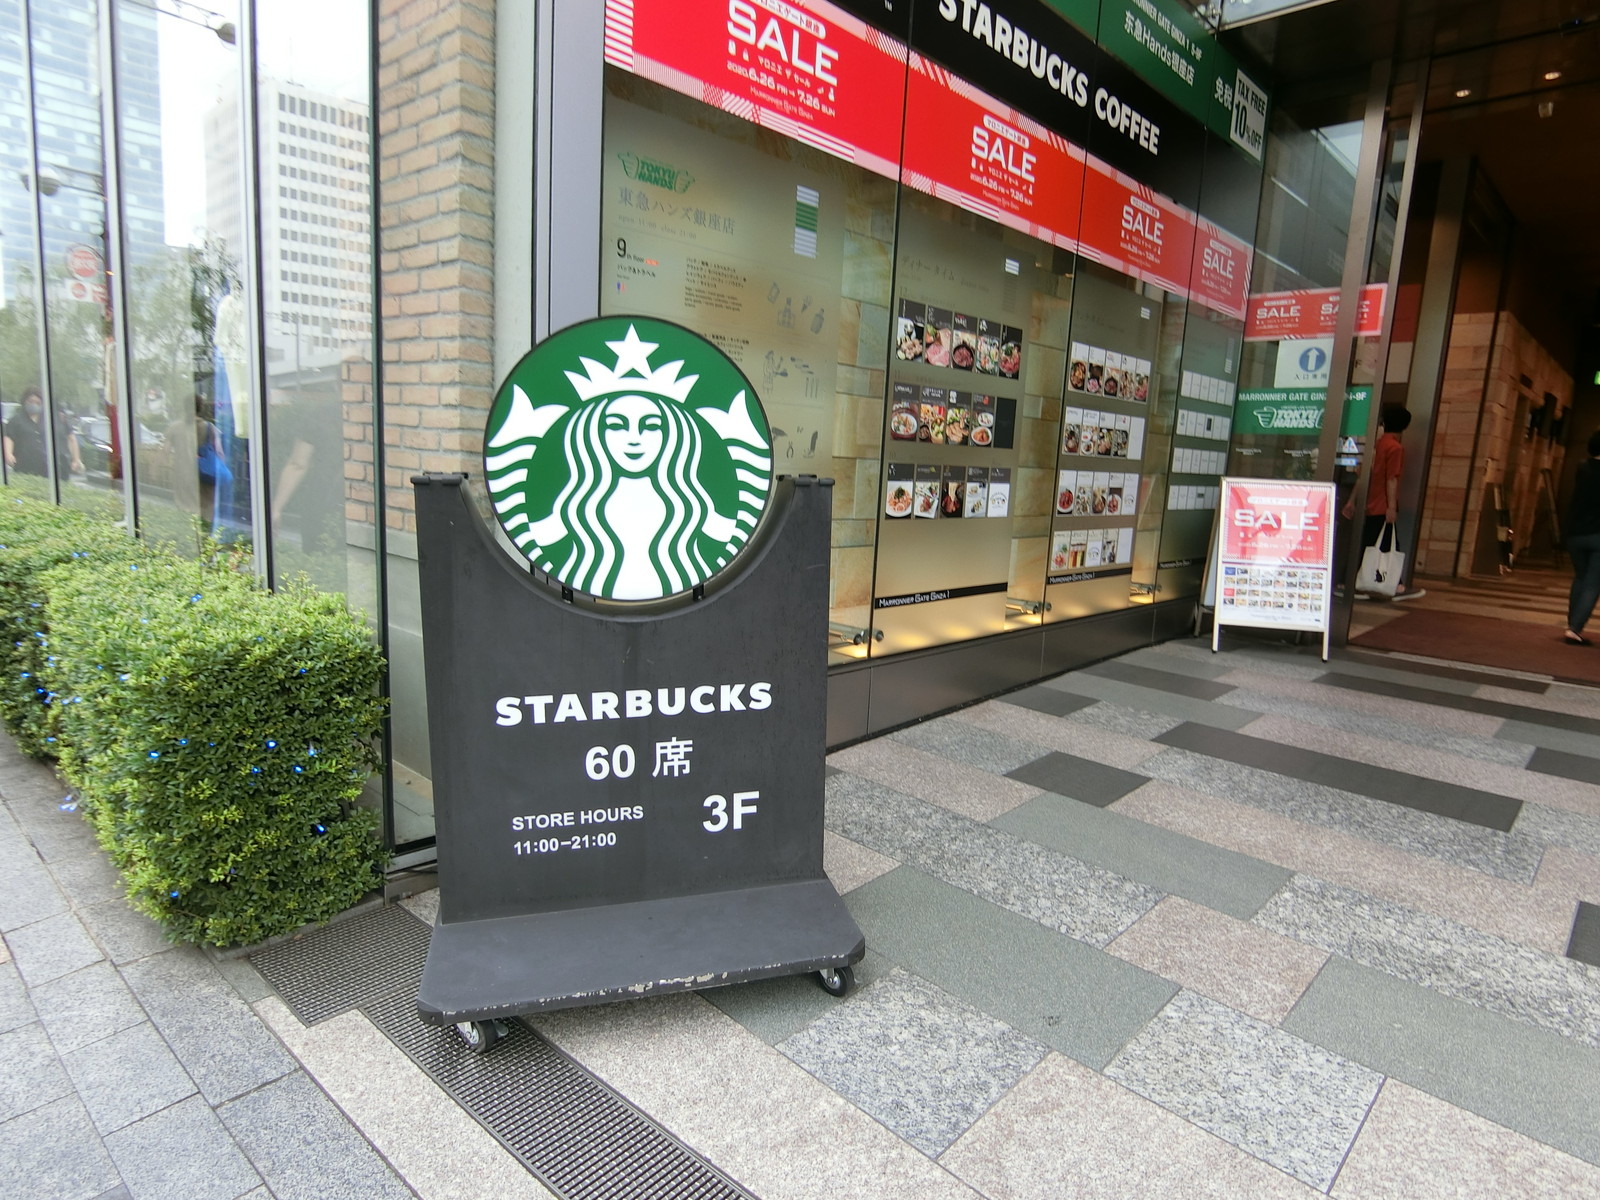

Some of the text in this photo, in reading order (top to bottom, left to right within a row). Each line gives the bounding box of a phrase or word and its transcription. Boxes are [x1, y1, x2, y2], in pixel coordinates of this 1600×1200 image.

[727, 0, 838, 87] SALE
[1157, 11, 1171, 35] GATE
[1171, 24, 1186, 49] GINZA
[938, 0, 1160, 155] STARBUCKS COFFEE
[1214, 76, 1233, 111] 免税
[1237, 79, 1266, 117] TAX FREE
[971, 125, 1037, 183] SALE
[618, 186, 736, 236] 東急ハンズ銀座店
[1121, 204, 1164, 246] SALE
[1202, 247, 1235, 280] SALE
[1256, 305, 1301, 319] SALE
[1239, 392, 1287, 402] MARRONNIER
[1288, 392, 1309, 401] GATE
[1278, 408, 1319, 420] TOKYU
[1274, 418, 1316, 429] HANDS
[1234, 508, 1320, 531] SALE
[495, 681, 773, 727] STARBUCKS
[585, 736, 694, 780] 60 席
[512, 805, 644, 831] STORE HOURS
[702, 790, 760, 832] 3F
